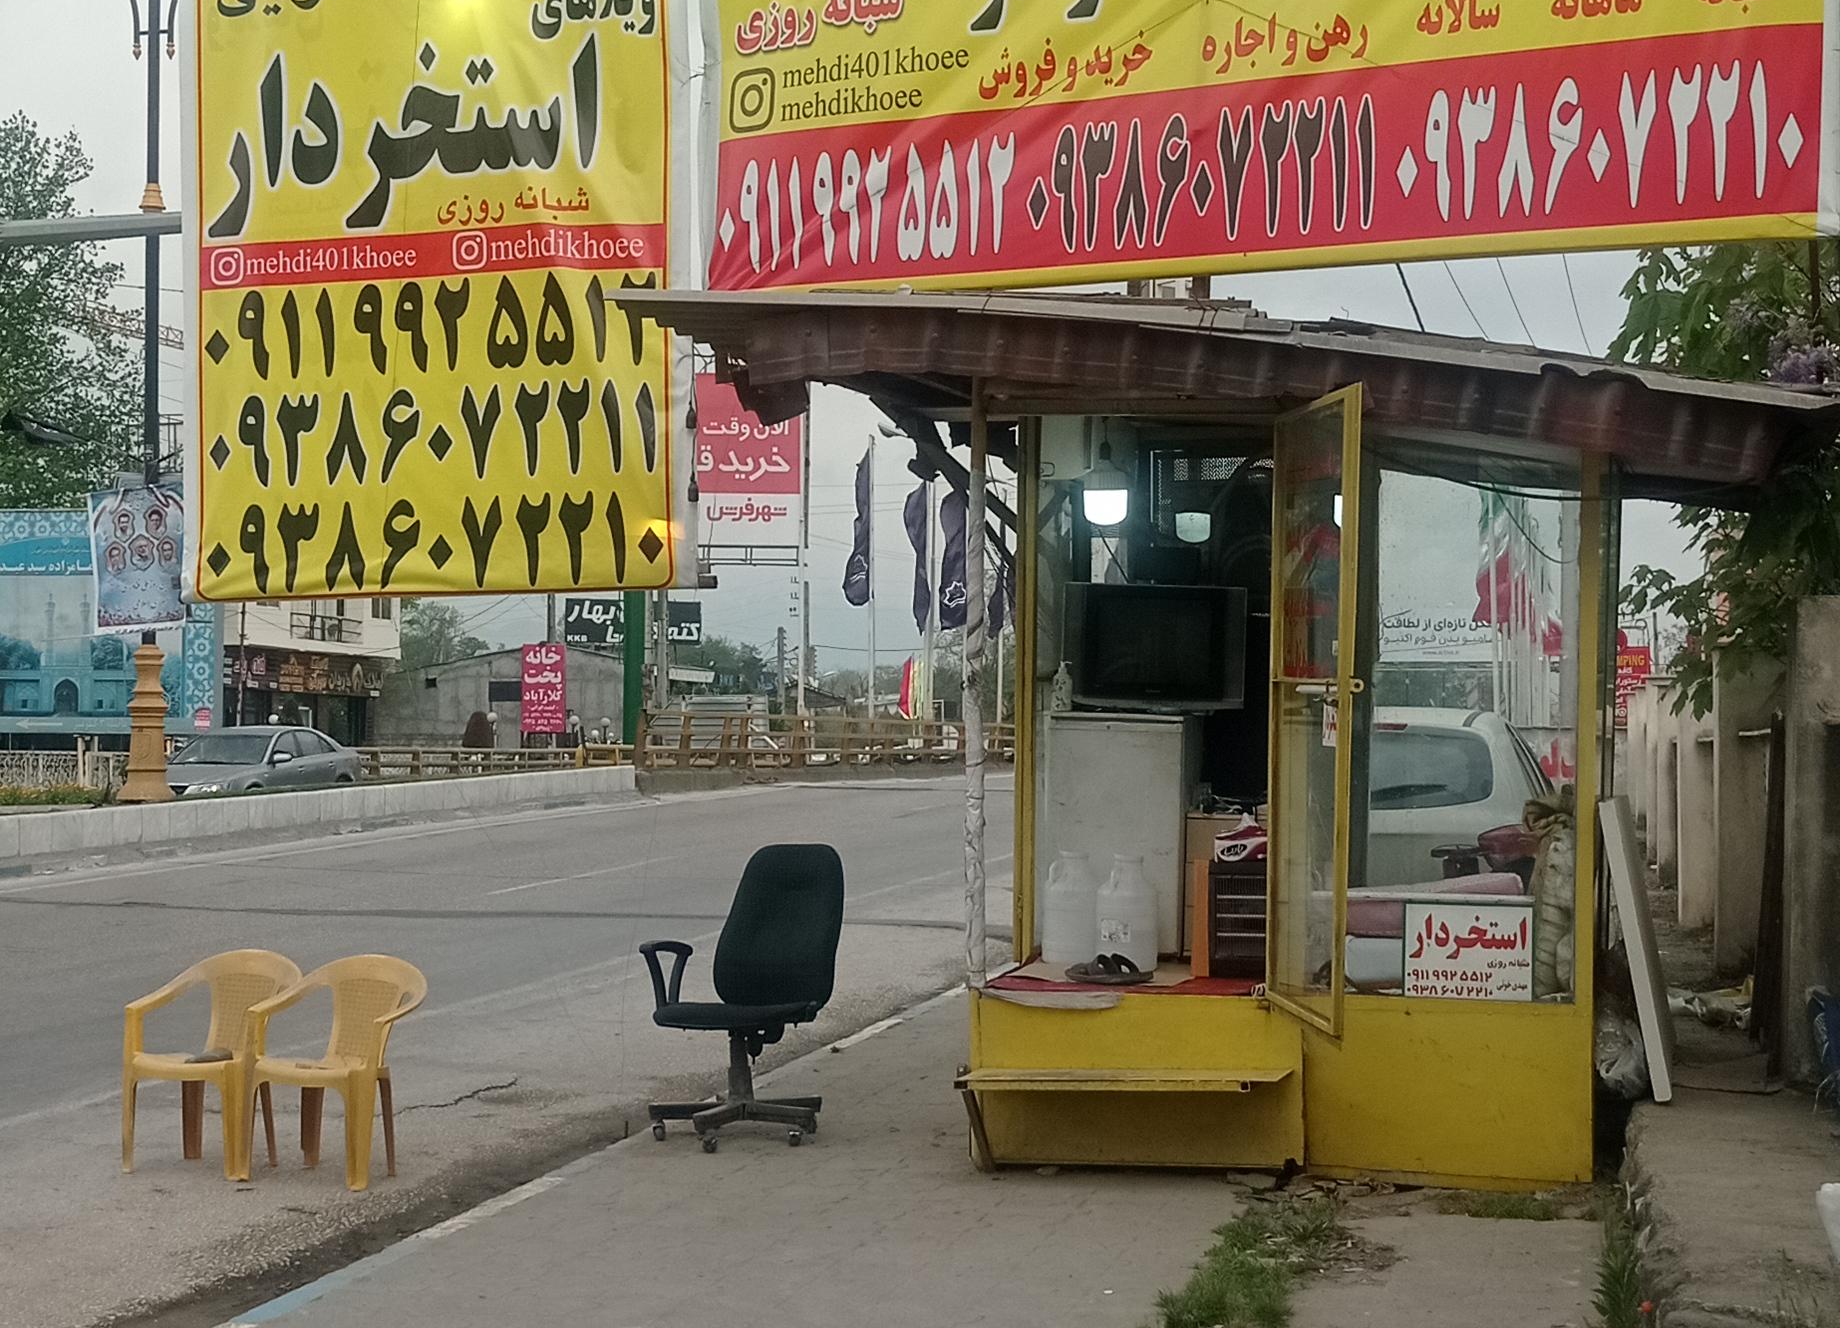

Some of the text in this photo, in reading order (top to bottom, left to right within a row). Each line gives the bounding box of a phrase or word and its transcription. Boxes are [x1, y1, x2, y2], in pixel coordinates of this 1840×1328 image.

[735, 4, 818, 57] روزی
[1202, 14, 1367, 74] رهن و اجاره
[782, 48, 970, 88] mehdi401khoee
[978, 30, 1153, 101] خرید و فروش
[781, 86, 924, 122] mehdikhoee
[438, 186, 590, 225] شبانه روزی
[246, 231, 644, 276] mehdi401khoee mehdikhoee
[703, 417, 750, 441] وقت
[719, 446, 791, 481] خرید
[525, 646, 561, 665] خانه
[524, 666, 562, 690] پخت
[1487, 960, 1507, 969] روزی
